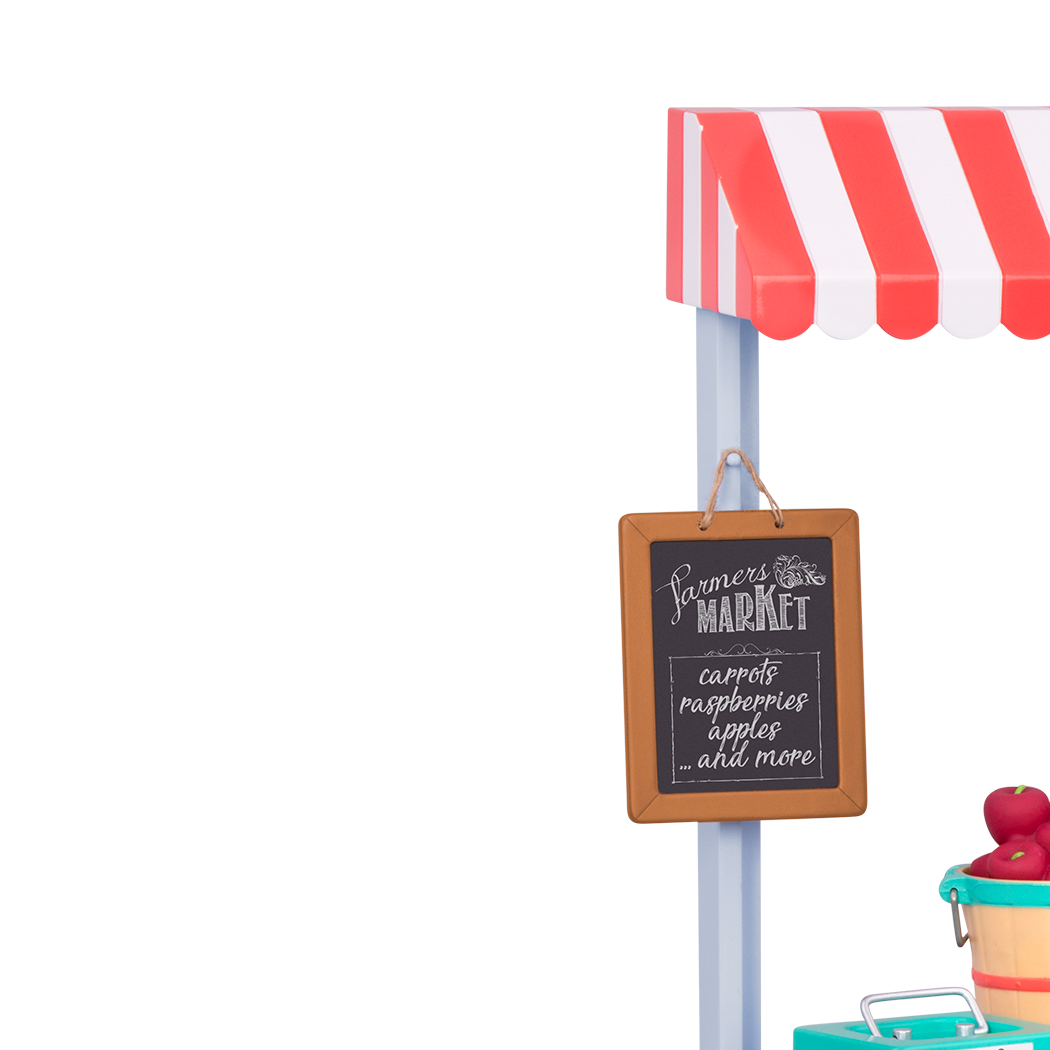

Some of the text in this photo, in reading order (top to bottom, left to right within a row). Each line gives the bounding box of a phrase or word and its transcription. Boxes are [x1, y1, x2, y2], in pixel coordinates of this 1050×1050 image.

[655, 563, 770, 625] farmers
[697, 584, 811, 633] MARKET
[699, 658, 782, 686] carrots
[679, 686, 809, 724] raspberries
[708, 712, 782, 752] apples
[697, 741, 749, 769] and
[755, 748, 816, 768] more
